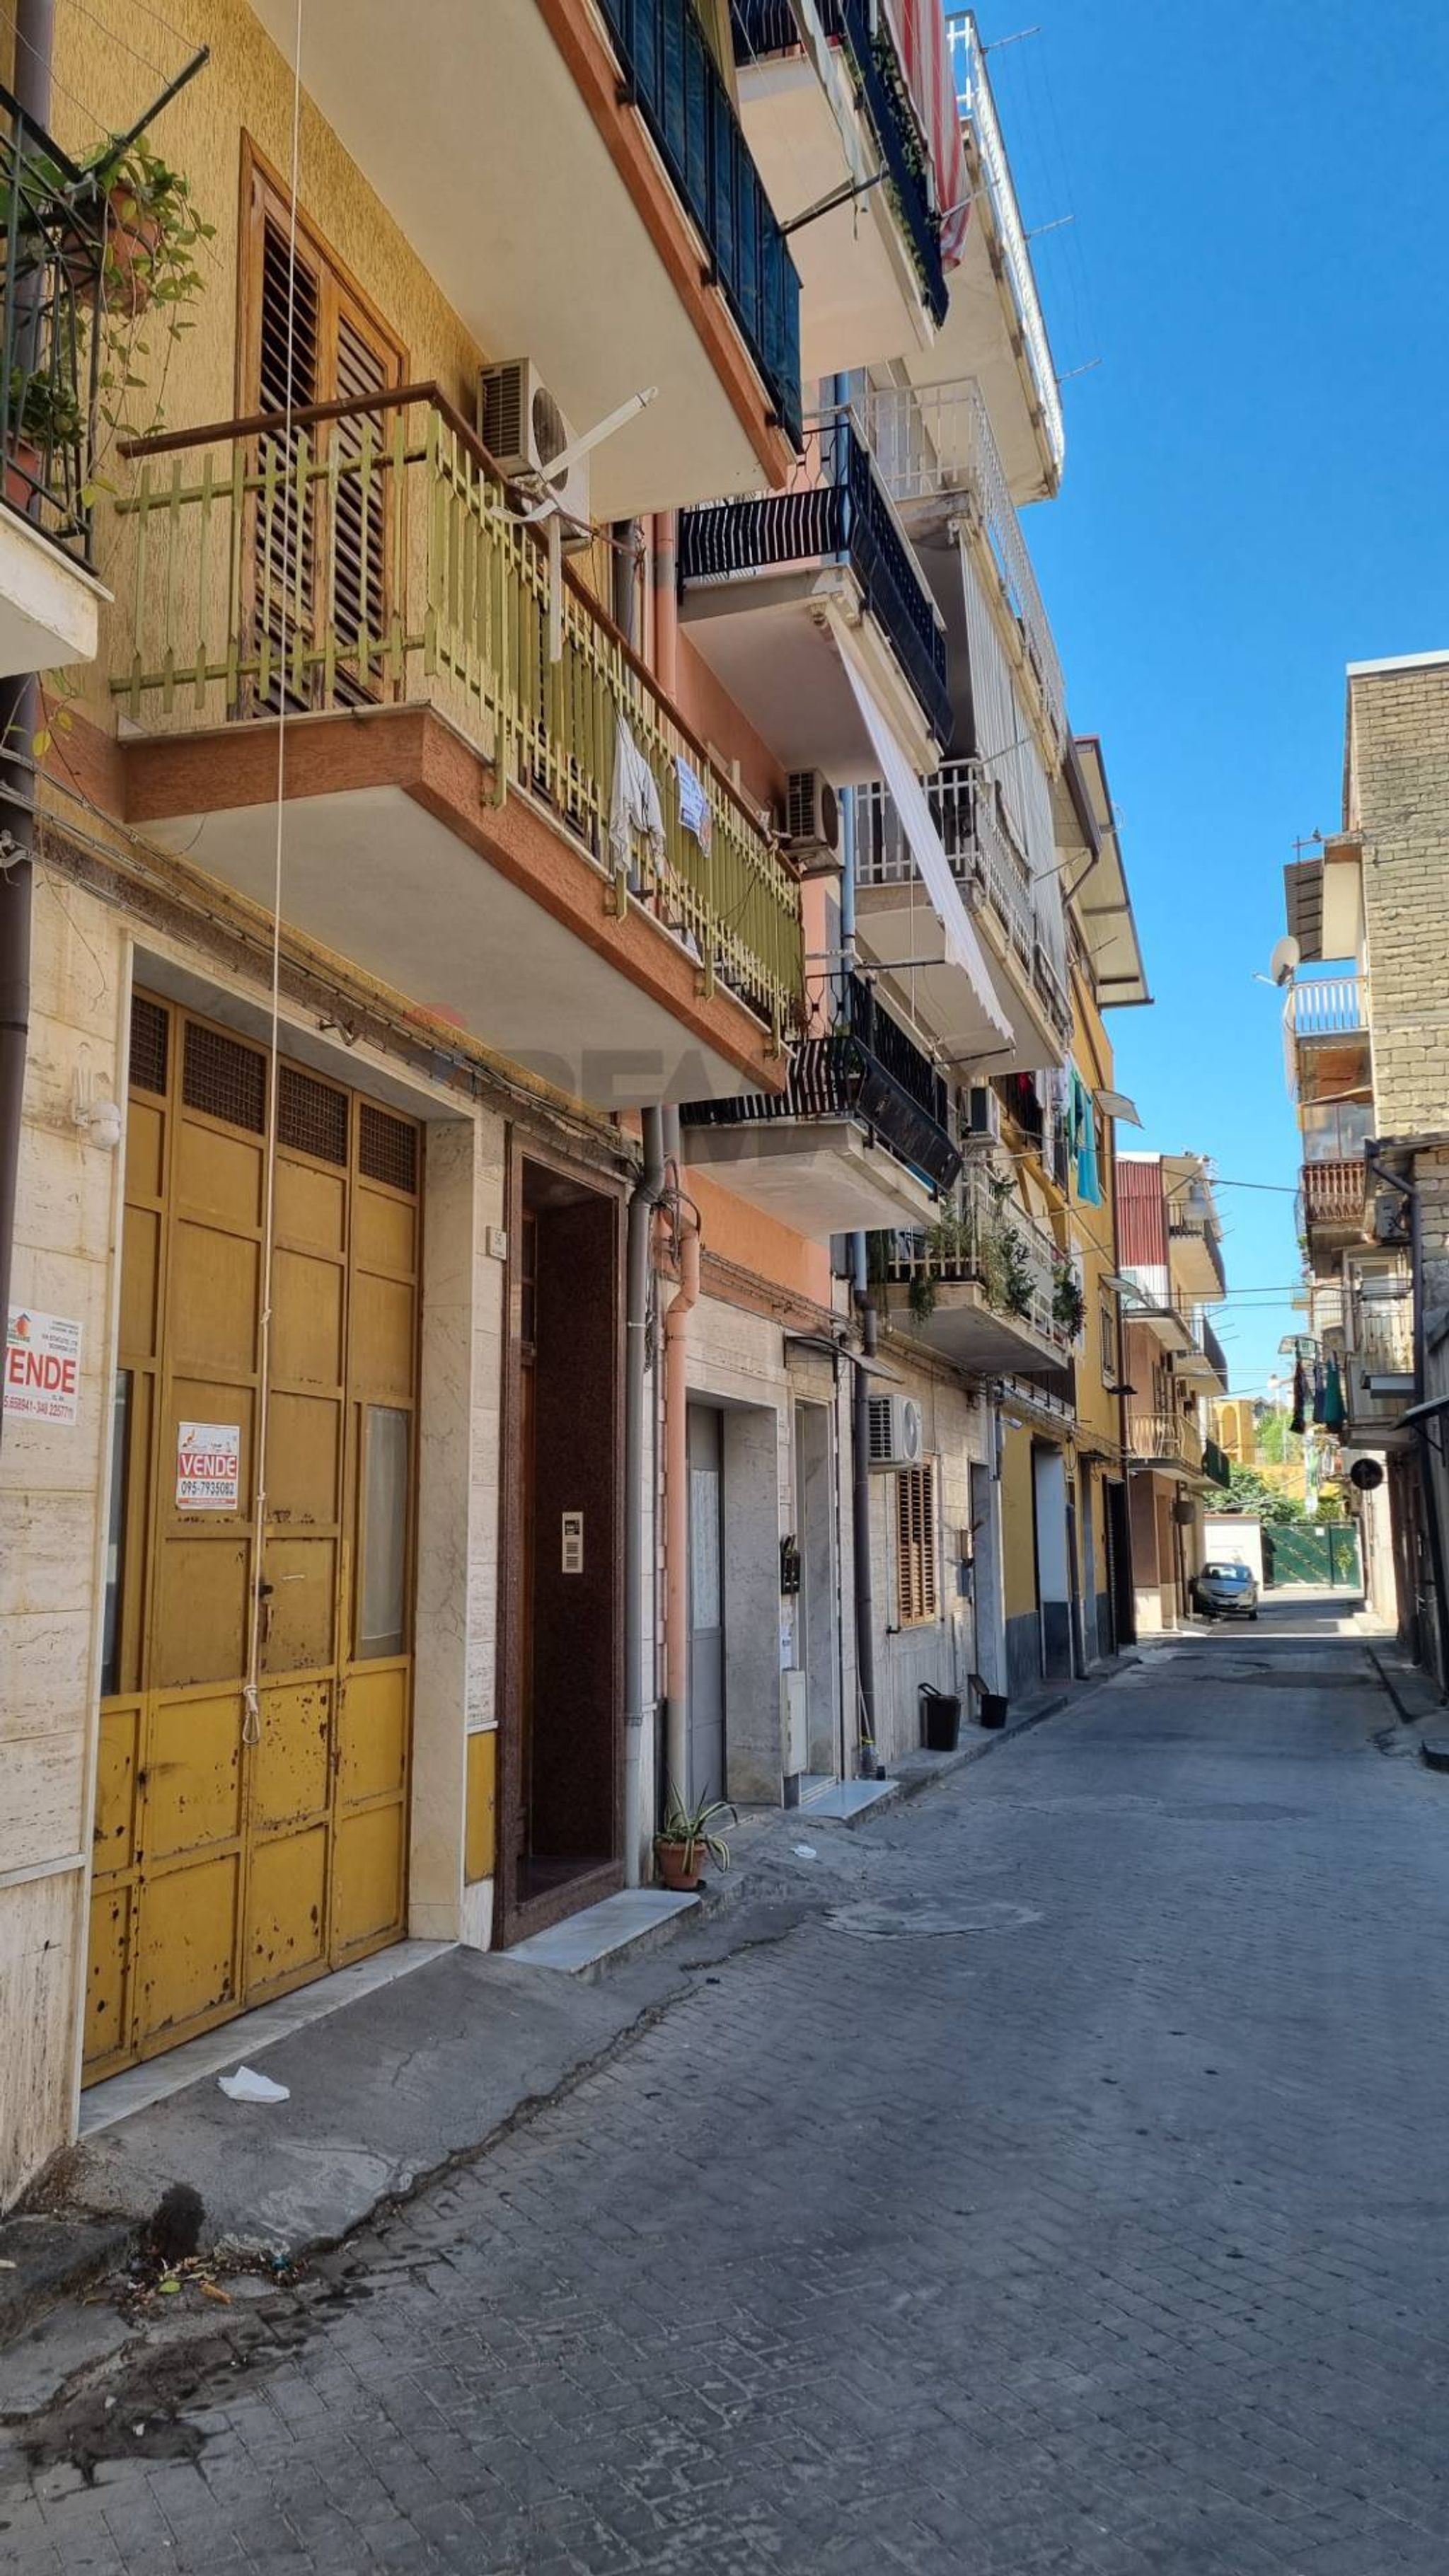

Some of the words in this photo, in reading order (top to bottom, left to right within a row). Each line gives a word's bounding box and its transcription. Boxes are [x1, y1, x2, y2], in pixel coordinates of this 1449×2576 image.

[6, 1347, 76, 1394] ENDE
[181, 1454, 236, 1477] VENDE
[181, 1481, 234, 1495] 095-7935082
